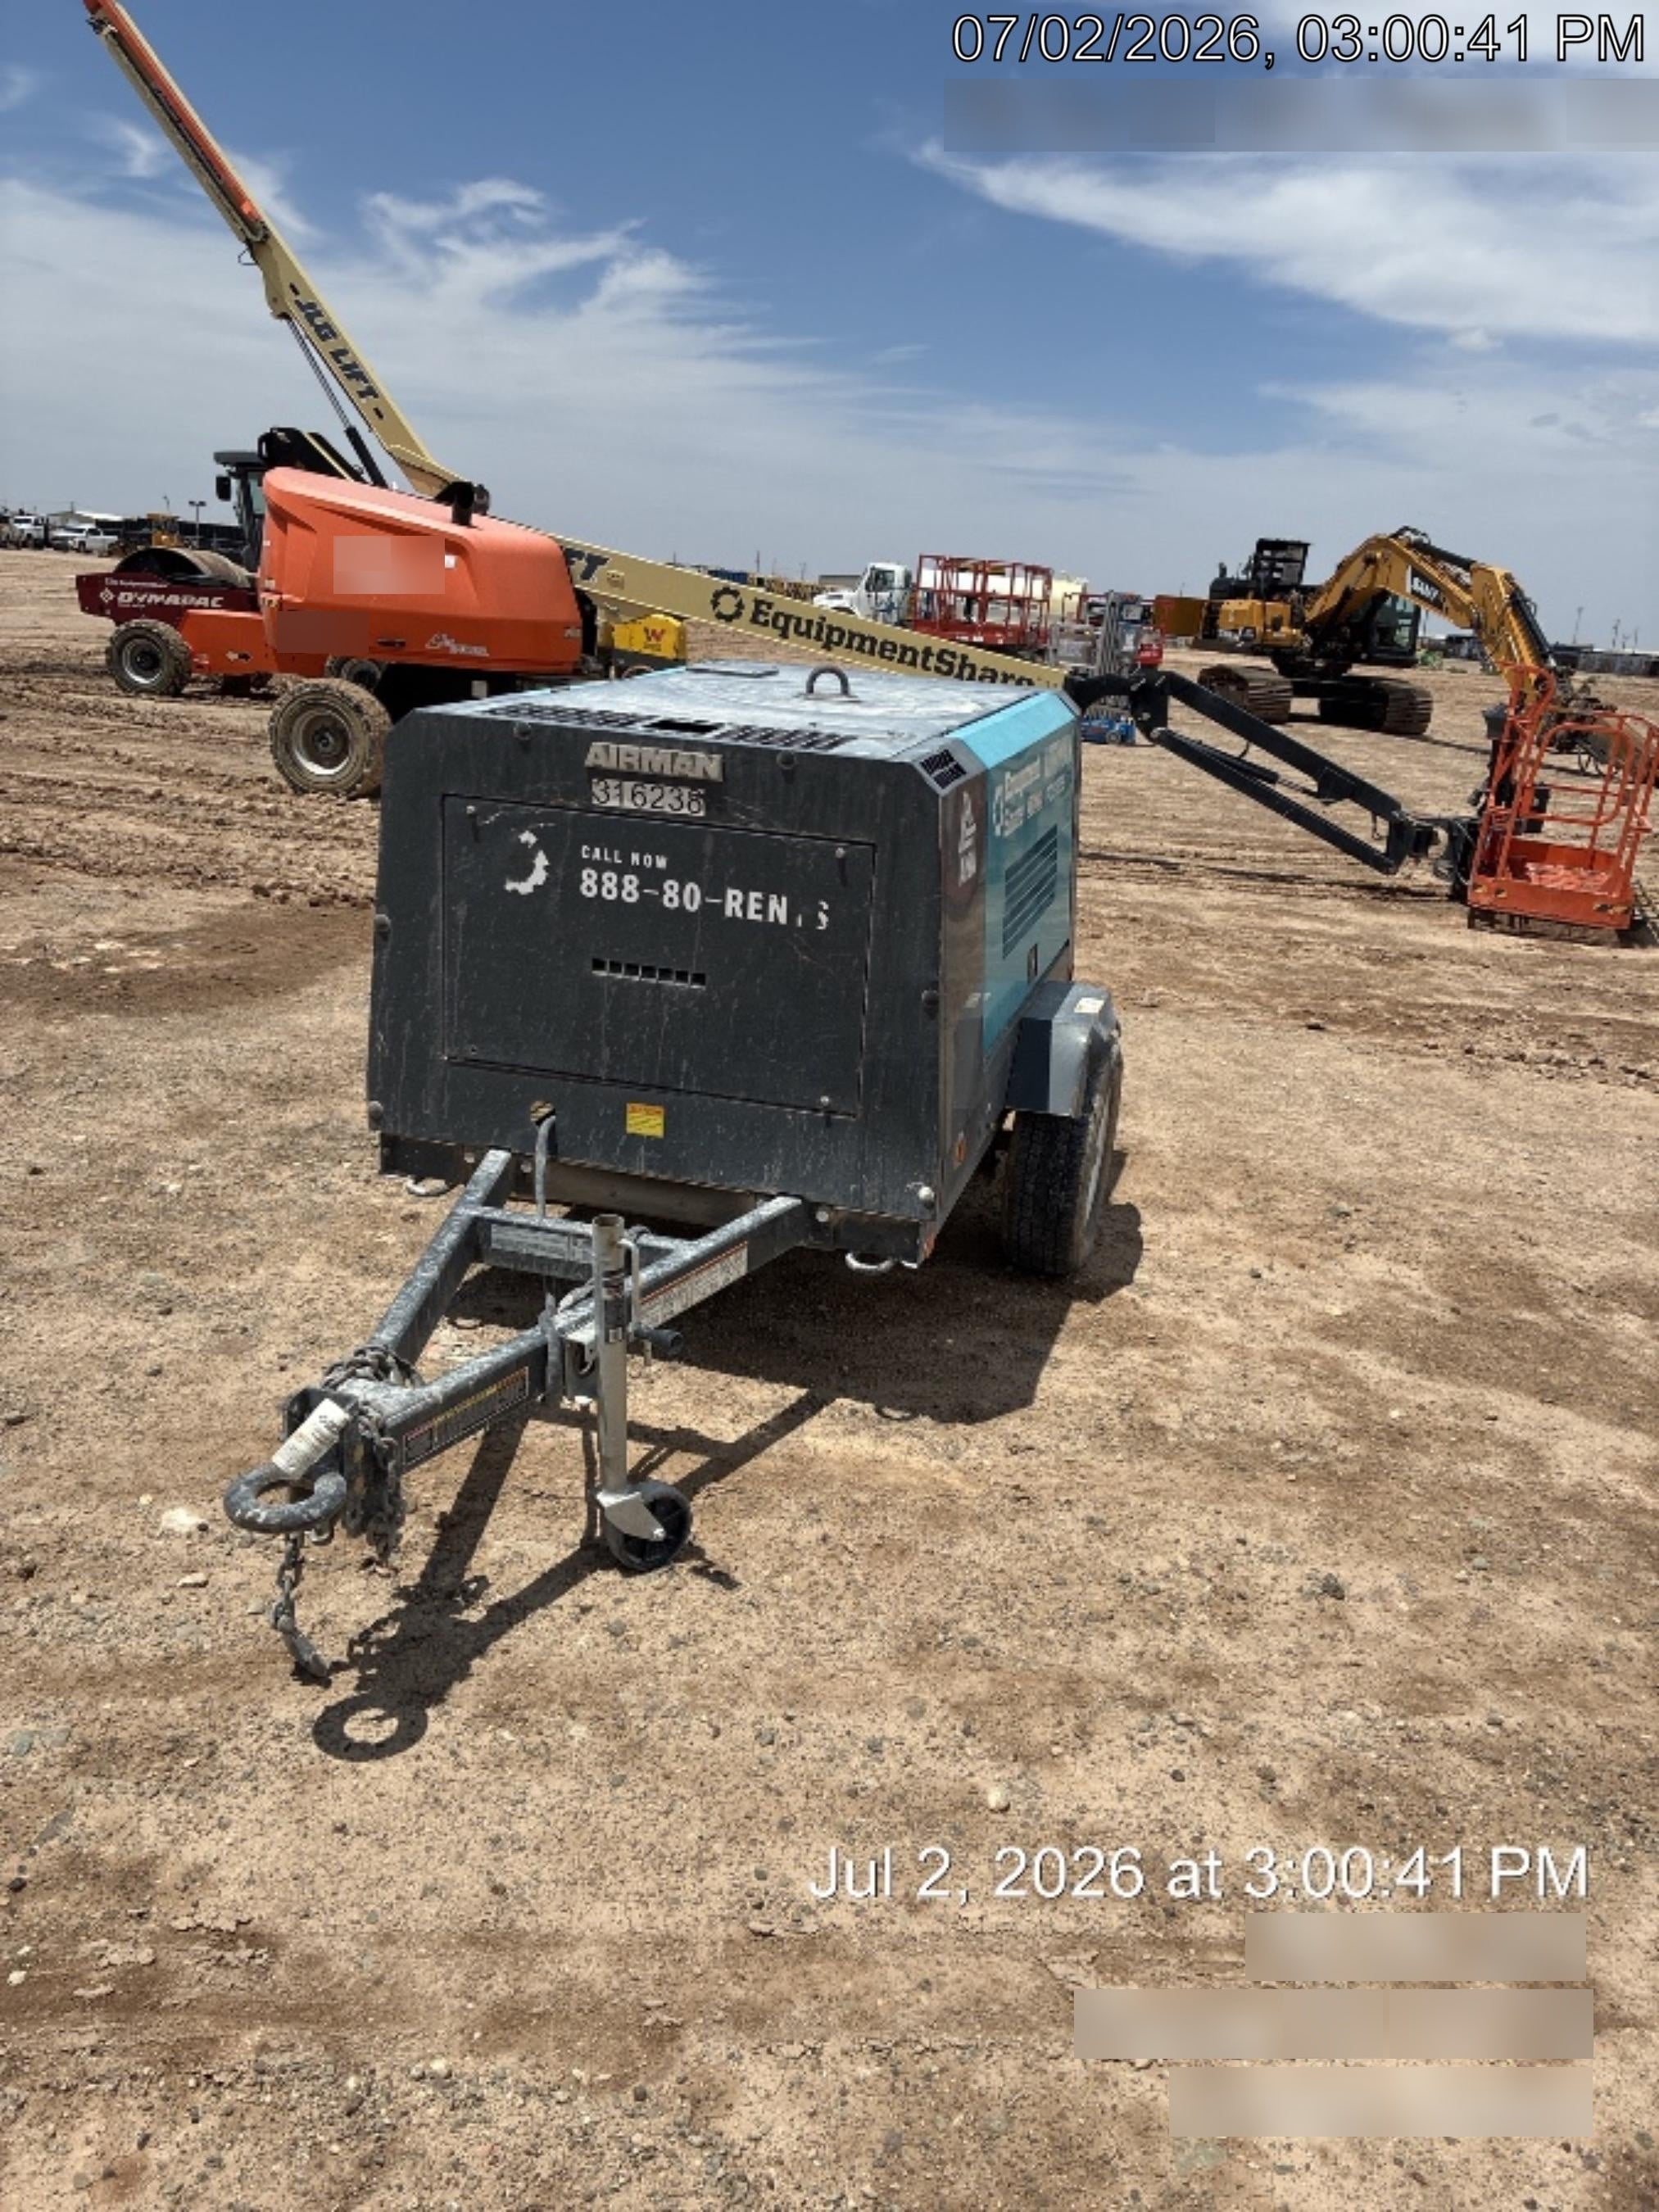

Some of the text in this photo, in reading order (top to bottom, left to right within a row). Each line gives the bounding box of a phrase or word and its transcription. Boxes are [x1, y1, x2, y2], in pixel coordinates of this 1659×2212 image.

[329, 348, 379, 400] LIFT
[584, 741, 723, 782] AIRMAN
[582, 845, 668, 869] CALL NOW
[580, 867, 830, 931] 888-80-RENS
